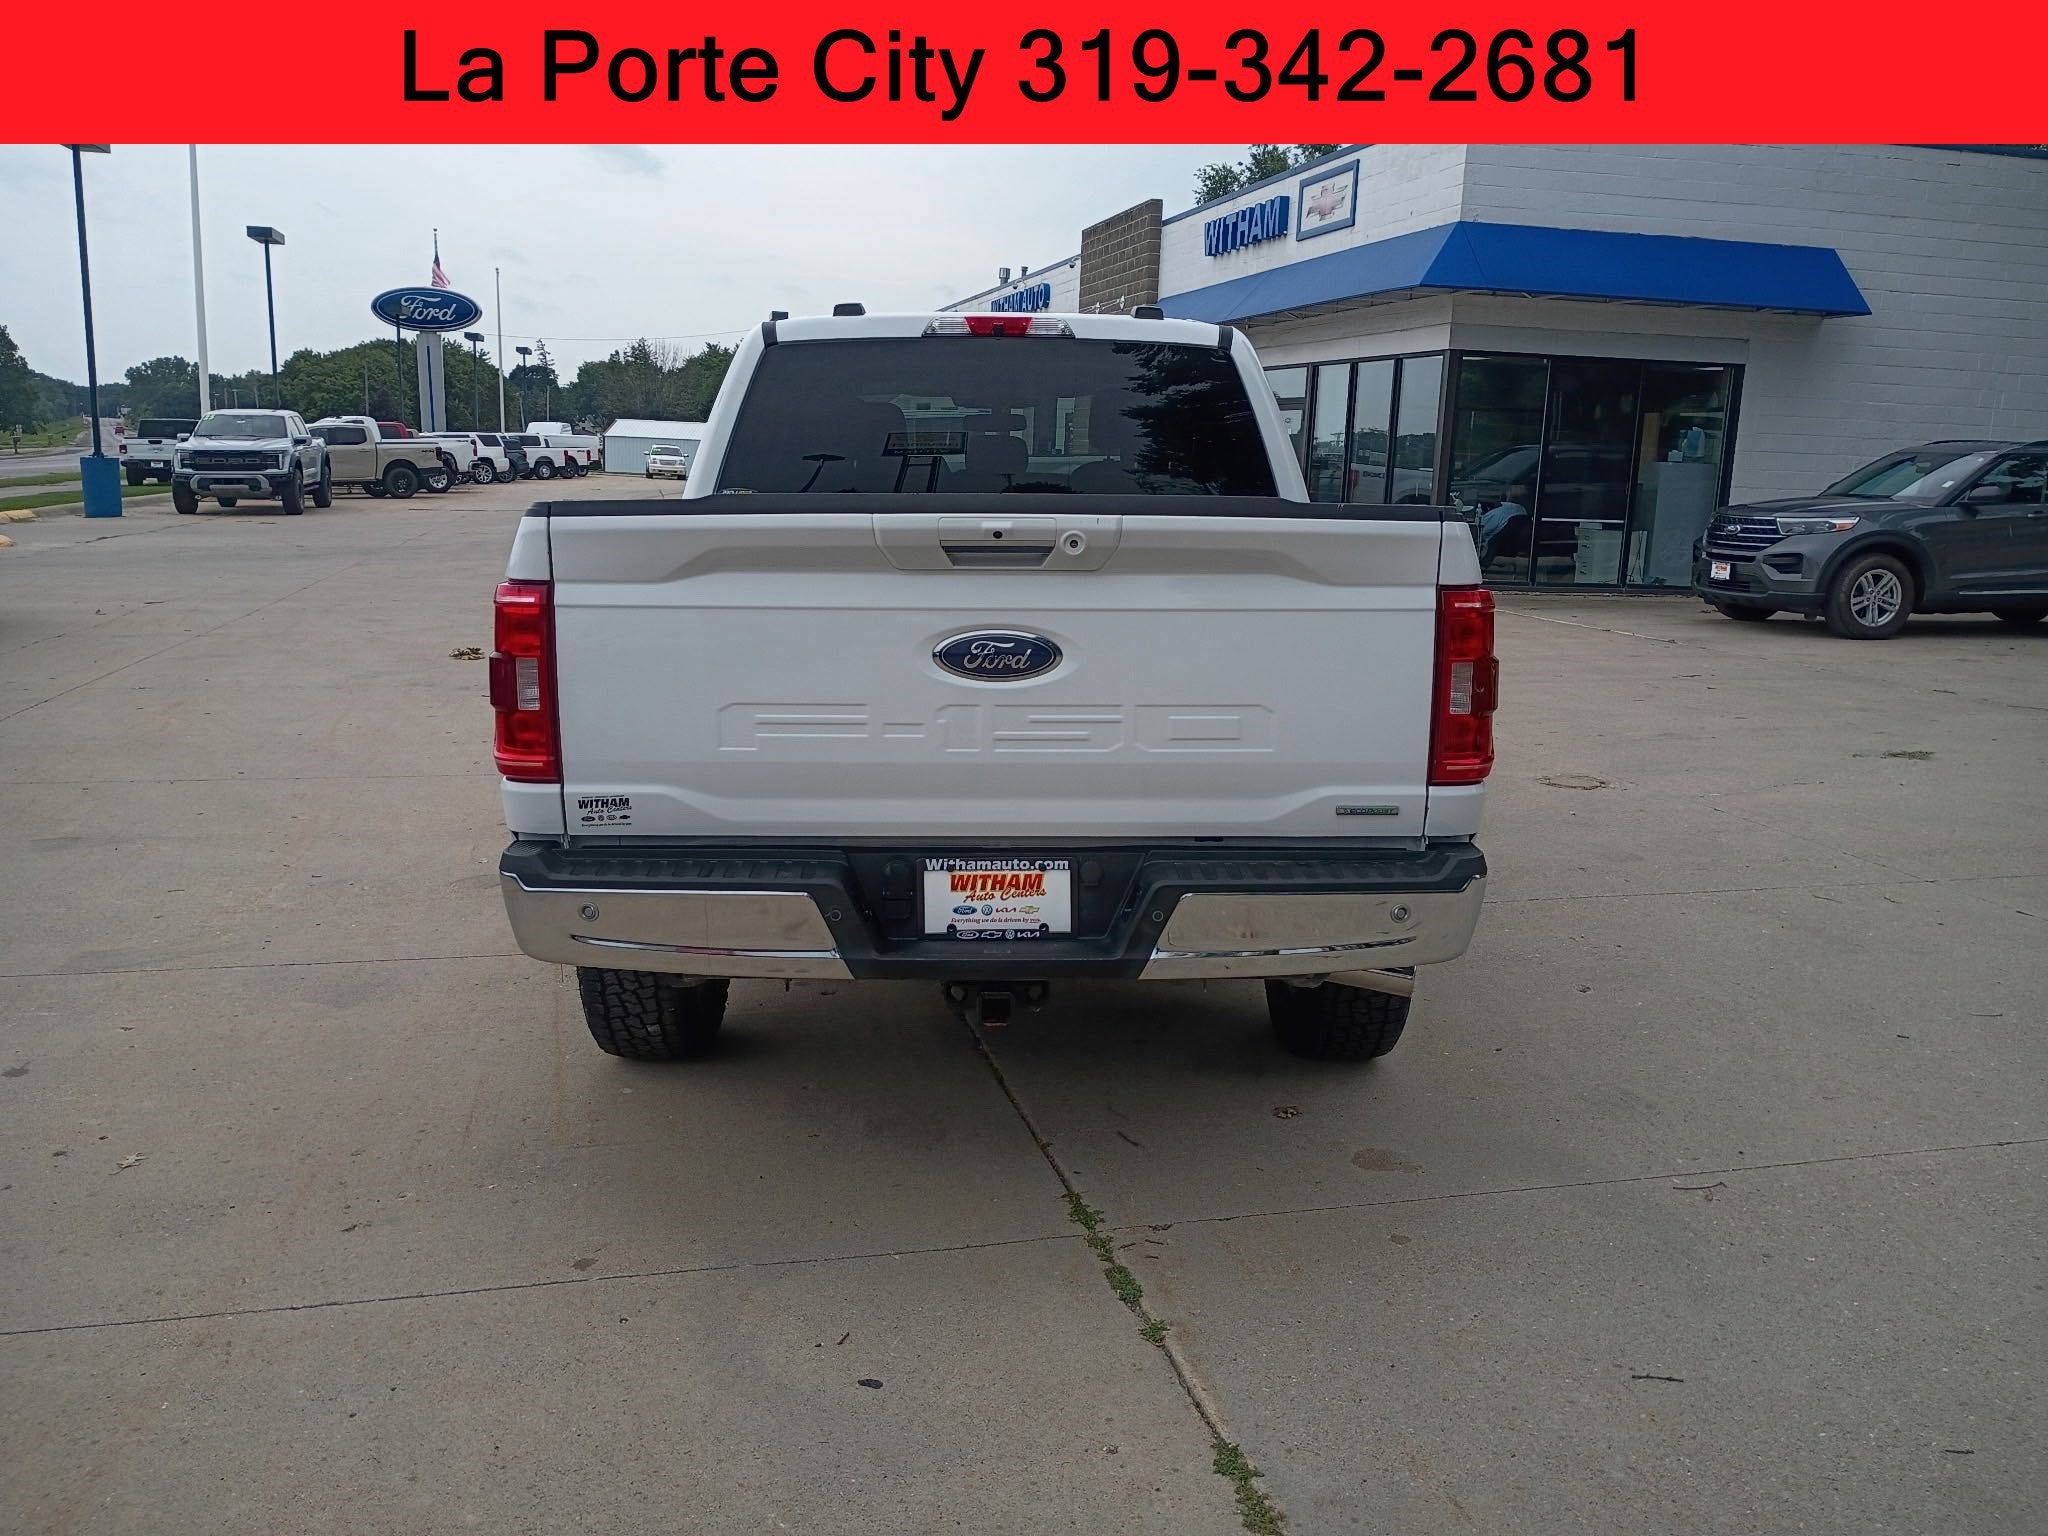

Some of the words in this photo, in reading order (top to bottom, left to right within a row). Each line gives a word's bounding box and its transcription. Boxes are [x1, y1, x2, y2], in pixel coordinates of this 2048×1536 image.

[1205, 196, 1285, 256] WITHAM
[399, 295, 457, 321] Ford
[1022, 283, 1047, 312] AUTO
[963, 640, 1032, 669] Ford
[717, 703, 1275, 752] F-150
[578, 798, 630, 809] WITHAM
[925, 858, 1069, 871] Withamauto.com
[950, 873, 1044, 892] WITHAM
[963, 889, 996, 903] Auto
[1000, 887, 1047, 901] Centers
